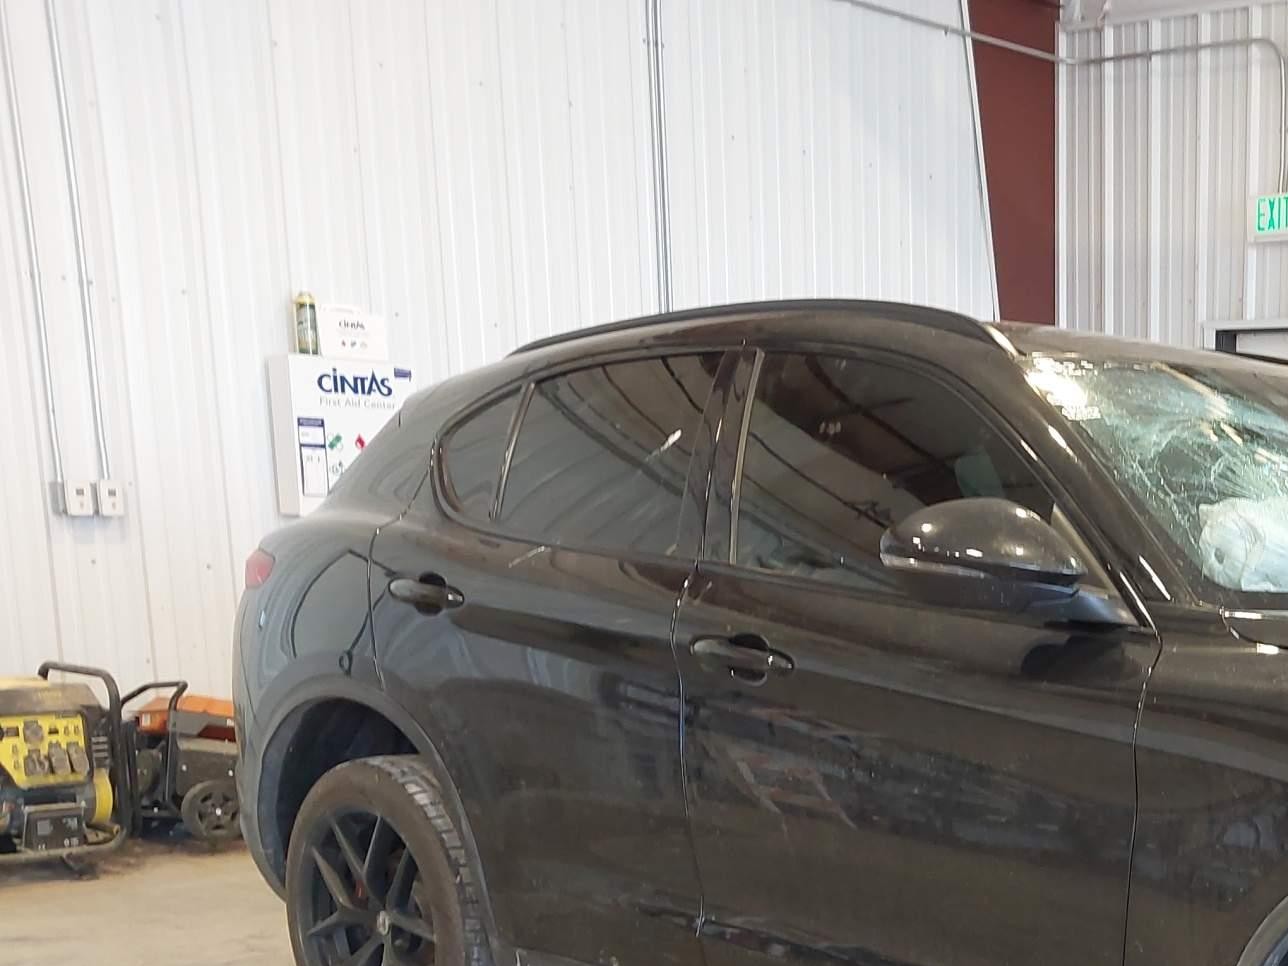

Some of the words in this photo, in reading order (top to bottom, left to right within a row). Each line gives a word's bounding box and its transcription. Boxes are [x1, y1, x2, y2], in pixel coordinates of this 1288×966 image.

[317, 368, 393, 397] CINTAS
[319, 396, 341, 408] First
[345, 397, 361, 409] Aid
[364, 399, 395, 410] Center
